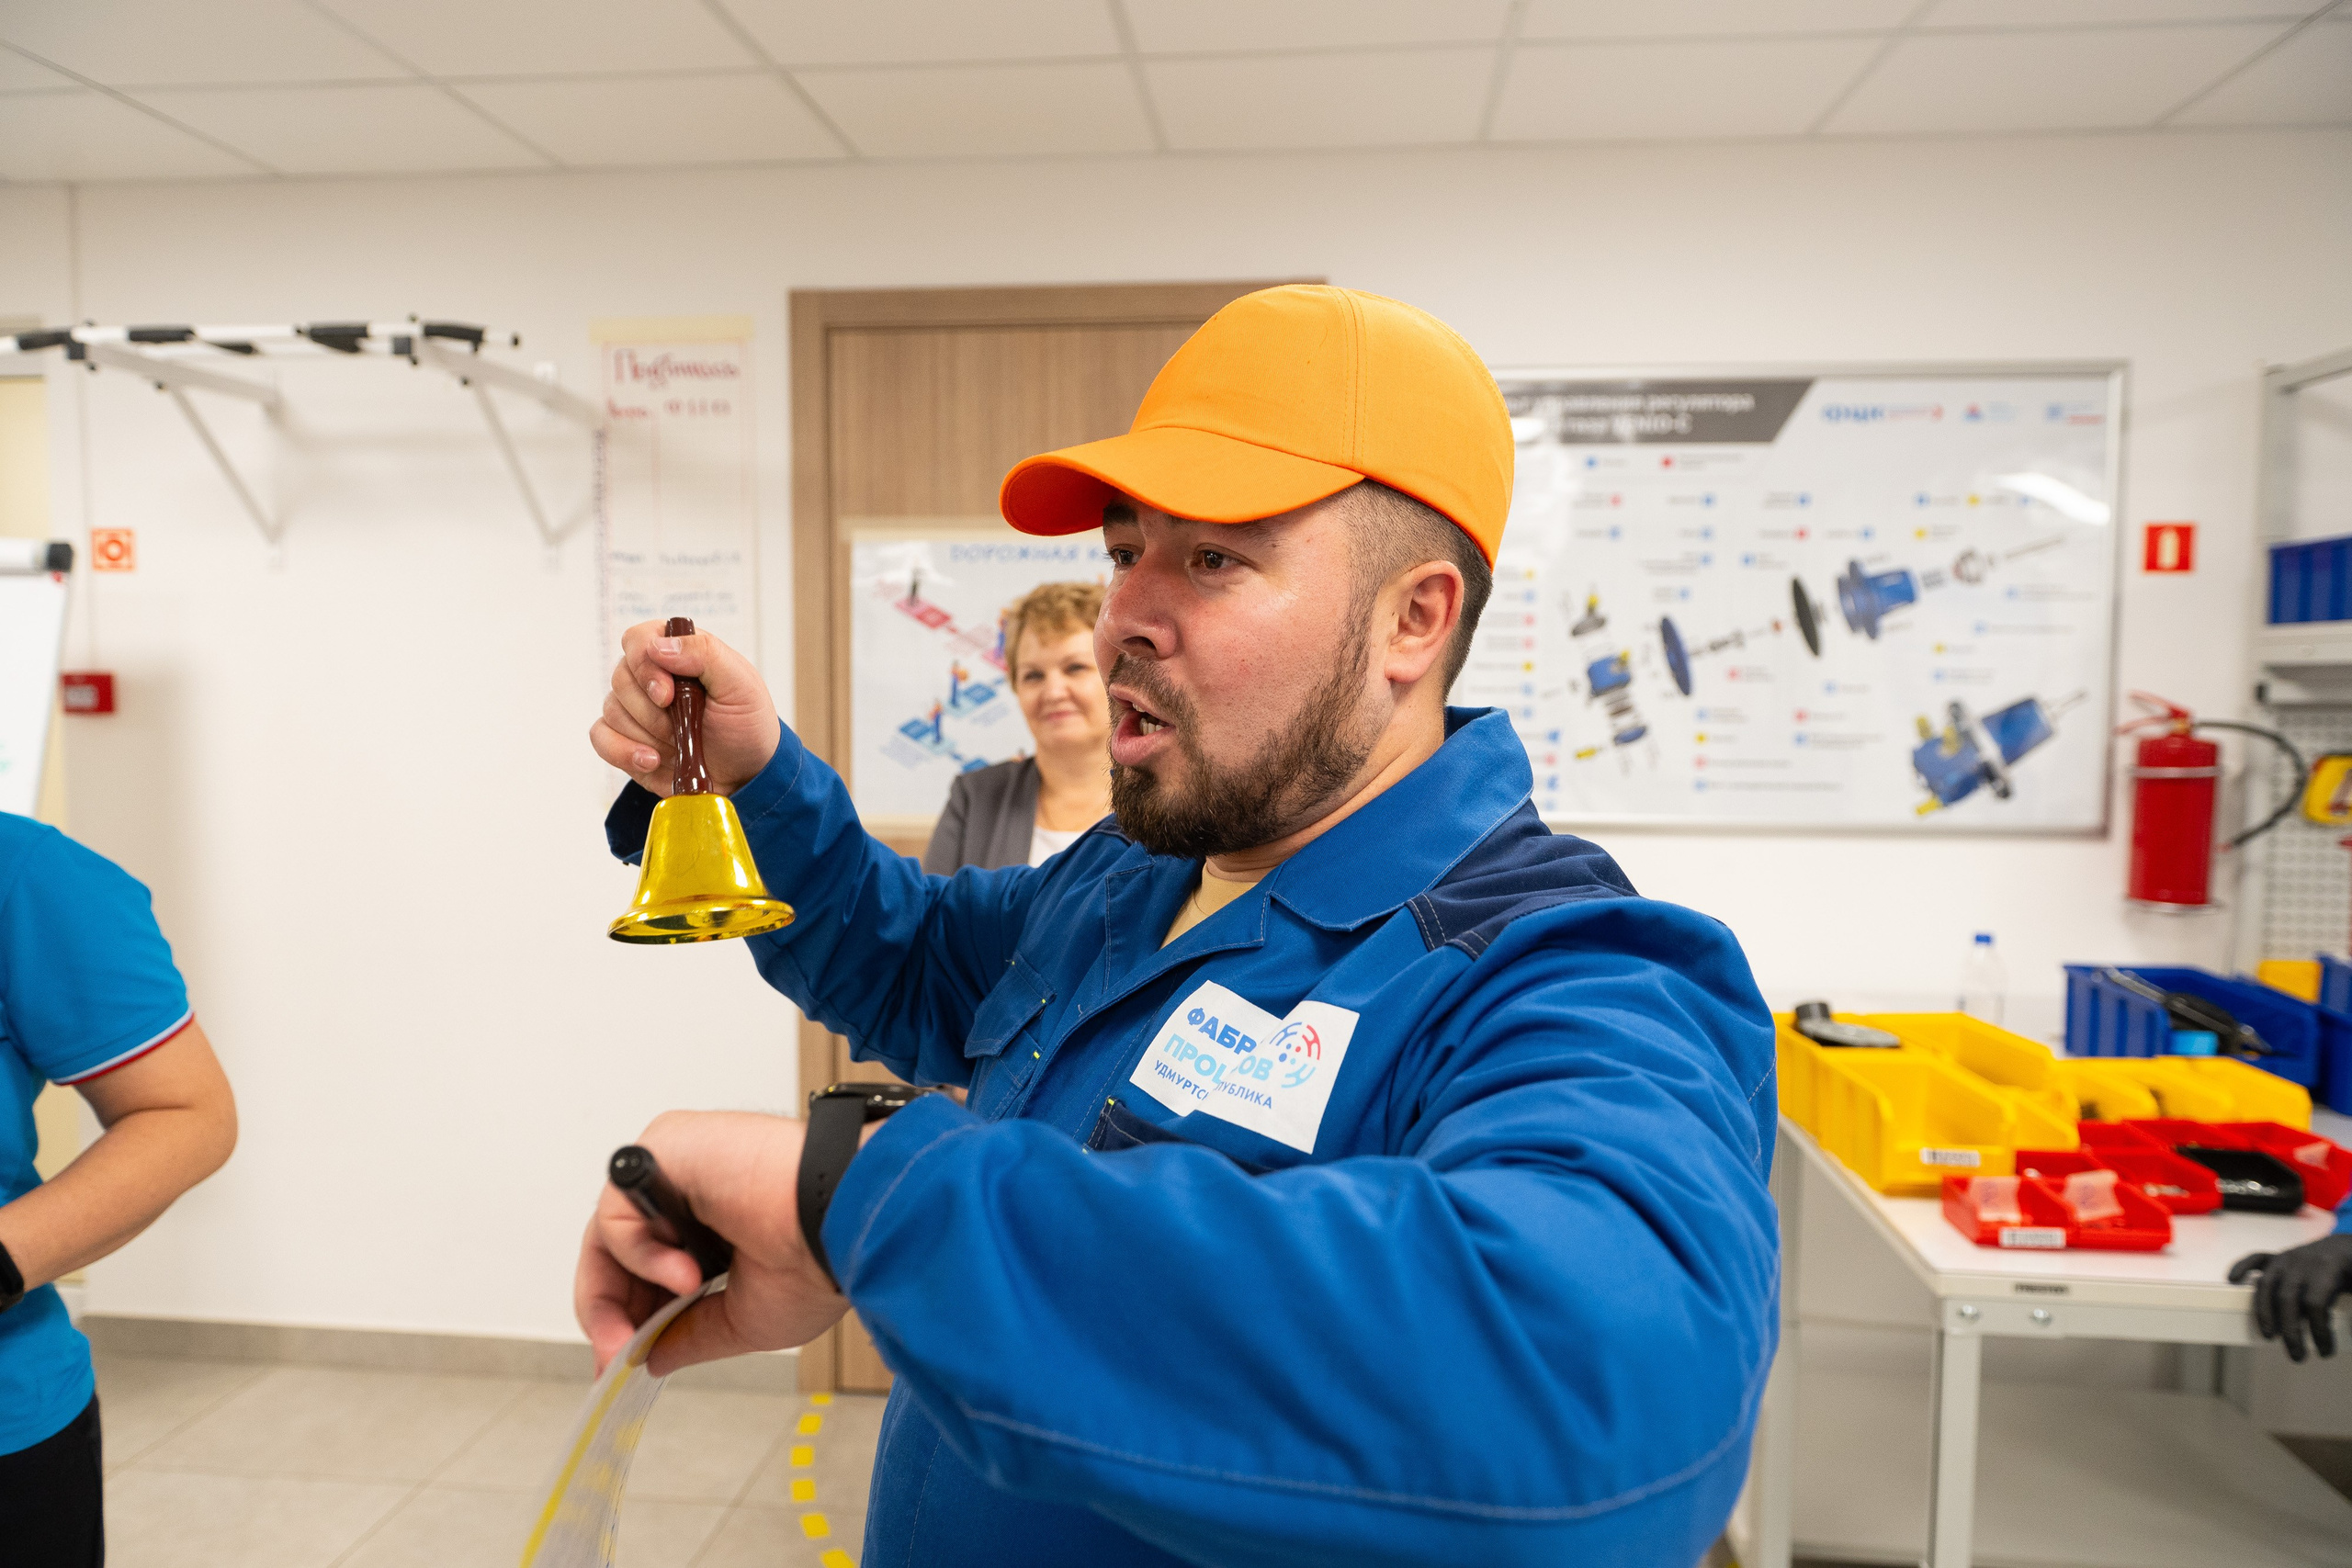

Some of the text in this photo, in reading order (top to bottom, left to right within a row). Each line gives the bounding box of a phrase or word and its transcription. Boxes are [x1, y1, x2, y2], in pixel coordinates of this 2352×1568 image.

[1187, 1007, 1259, 1055] ФАБР
[1154, 1059, 1272, 1110] УДМУРТС ПУБЛИКА
